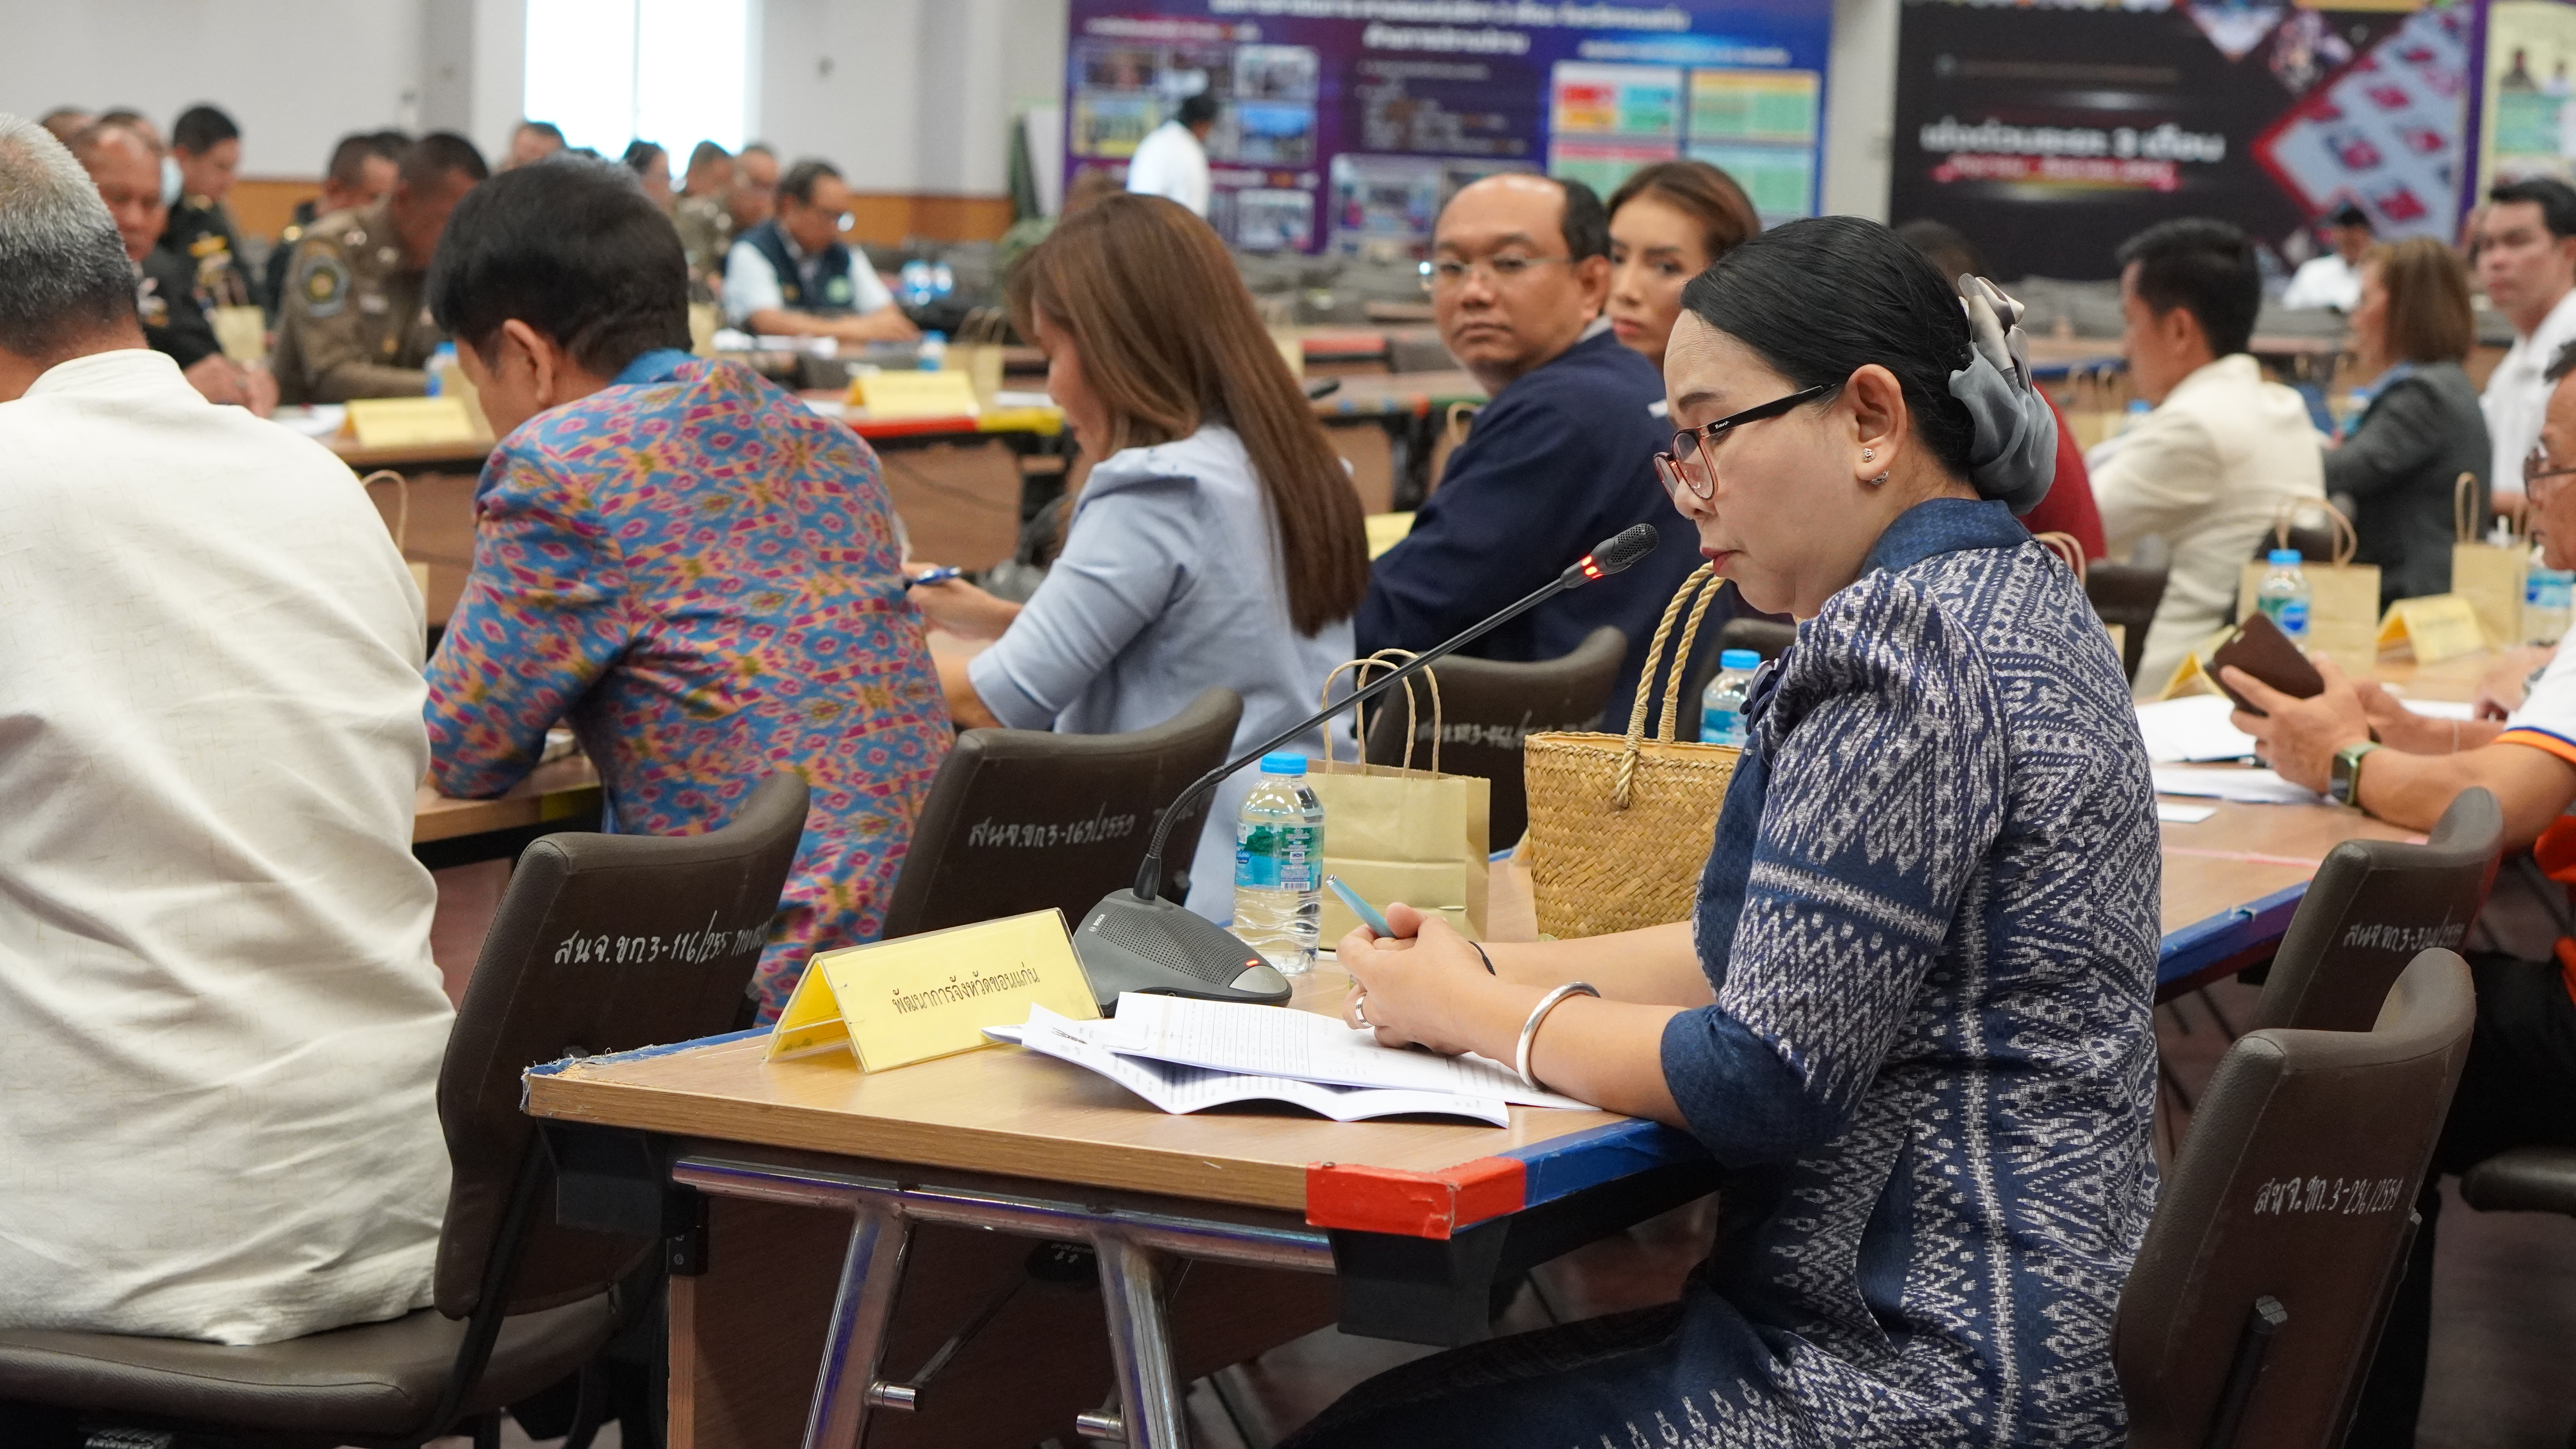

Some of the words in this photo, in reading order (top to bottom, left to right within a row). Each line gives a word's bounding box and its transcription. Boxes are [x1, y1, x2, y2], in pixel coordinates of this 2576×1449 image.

[1093, 914, 1106, 926] BOSCH
[892, 961, 1040, 1014] พัฒนาการจังหวัดขอนแก่น
